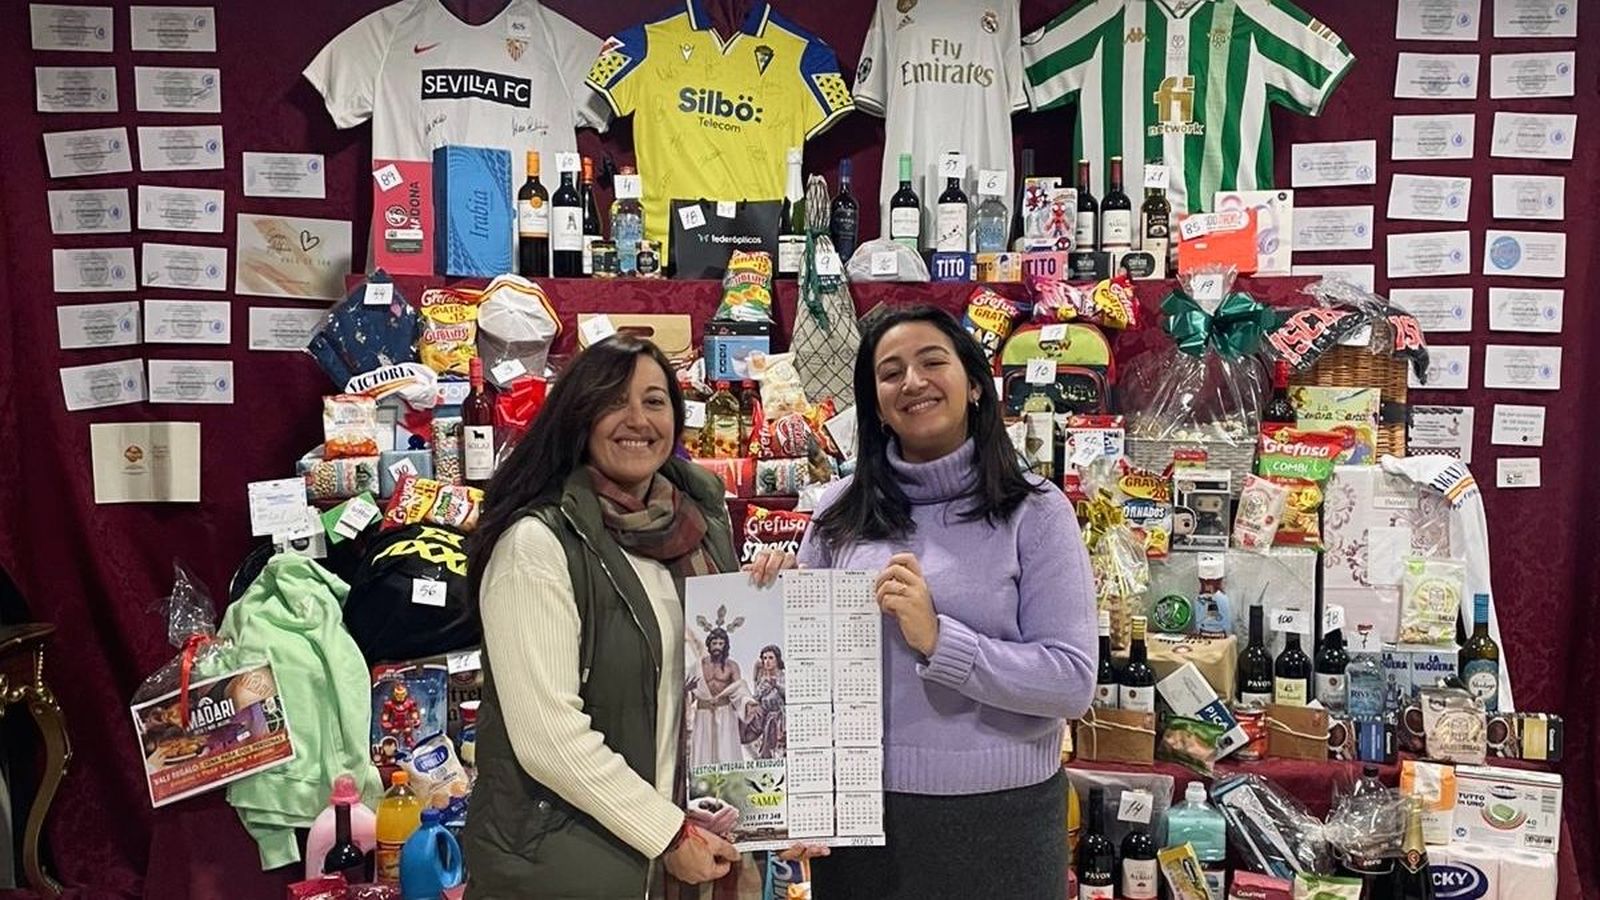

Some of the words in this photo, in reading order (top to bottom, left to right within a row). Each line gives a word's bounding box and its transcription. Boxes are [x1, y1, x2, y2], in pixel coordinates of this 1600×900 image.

[931, 38, 962, 60] Fly
[902, 59, 995, 88] Emirates
[424, 75, 498, 97] SEVILLA
[503, 84, 529, 102] FC
[699, 117, 741, 133] Telecom
[1148, 123, 1205, 136] network
[380, 171, 397, 187] 89
[623, 179, 632, 192] 4
[987, 175, 997, 189] 6
[711, 234, 762, 244] federópticos
[820, 257, 830, 270] 9
[936, 259, 965, 278] TITO
[1025, 258, 1056, 276] TITO
[349, 366, 416, 393] VICTORIA
[1264, 440, 1330, 457] Grefusa
[1272, 461, 1310, 473] COMBI
[1123, 506, 1166, 519] ORNADOS
[747, 515, 807, 535] Grefusa
[420, 584, 437, 598] 56
[1277, 614, 1294, 624] 100
[1428, 655, 1440, 663] LA
[1414, 661, 1456, 672] VAQUERA
[1458, 793, 1485, 801] TUTTO
[1432, 872, 1469, 886] CKY
